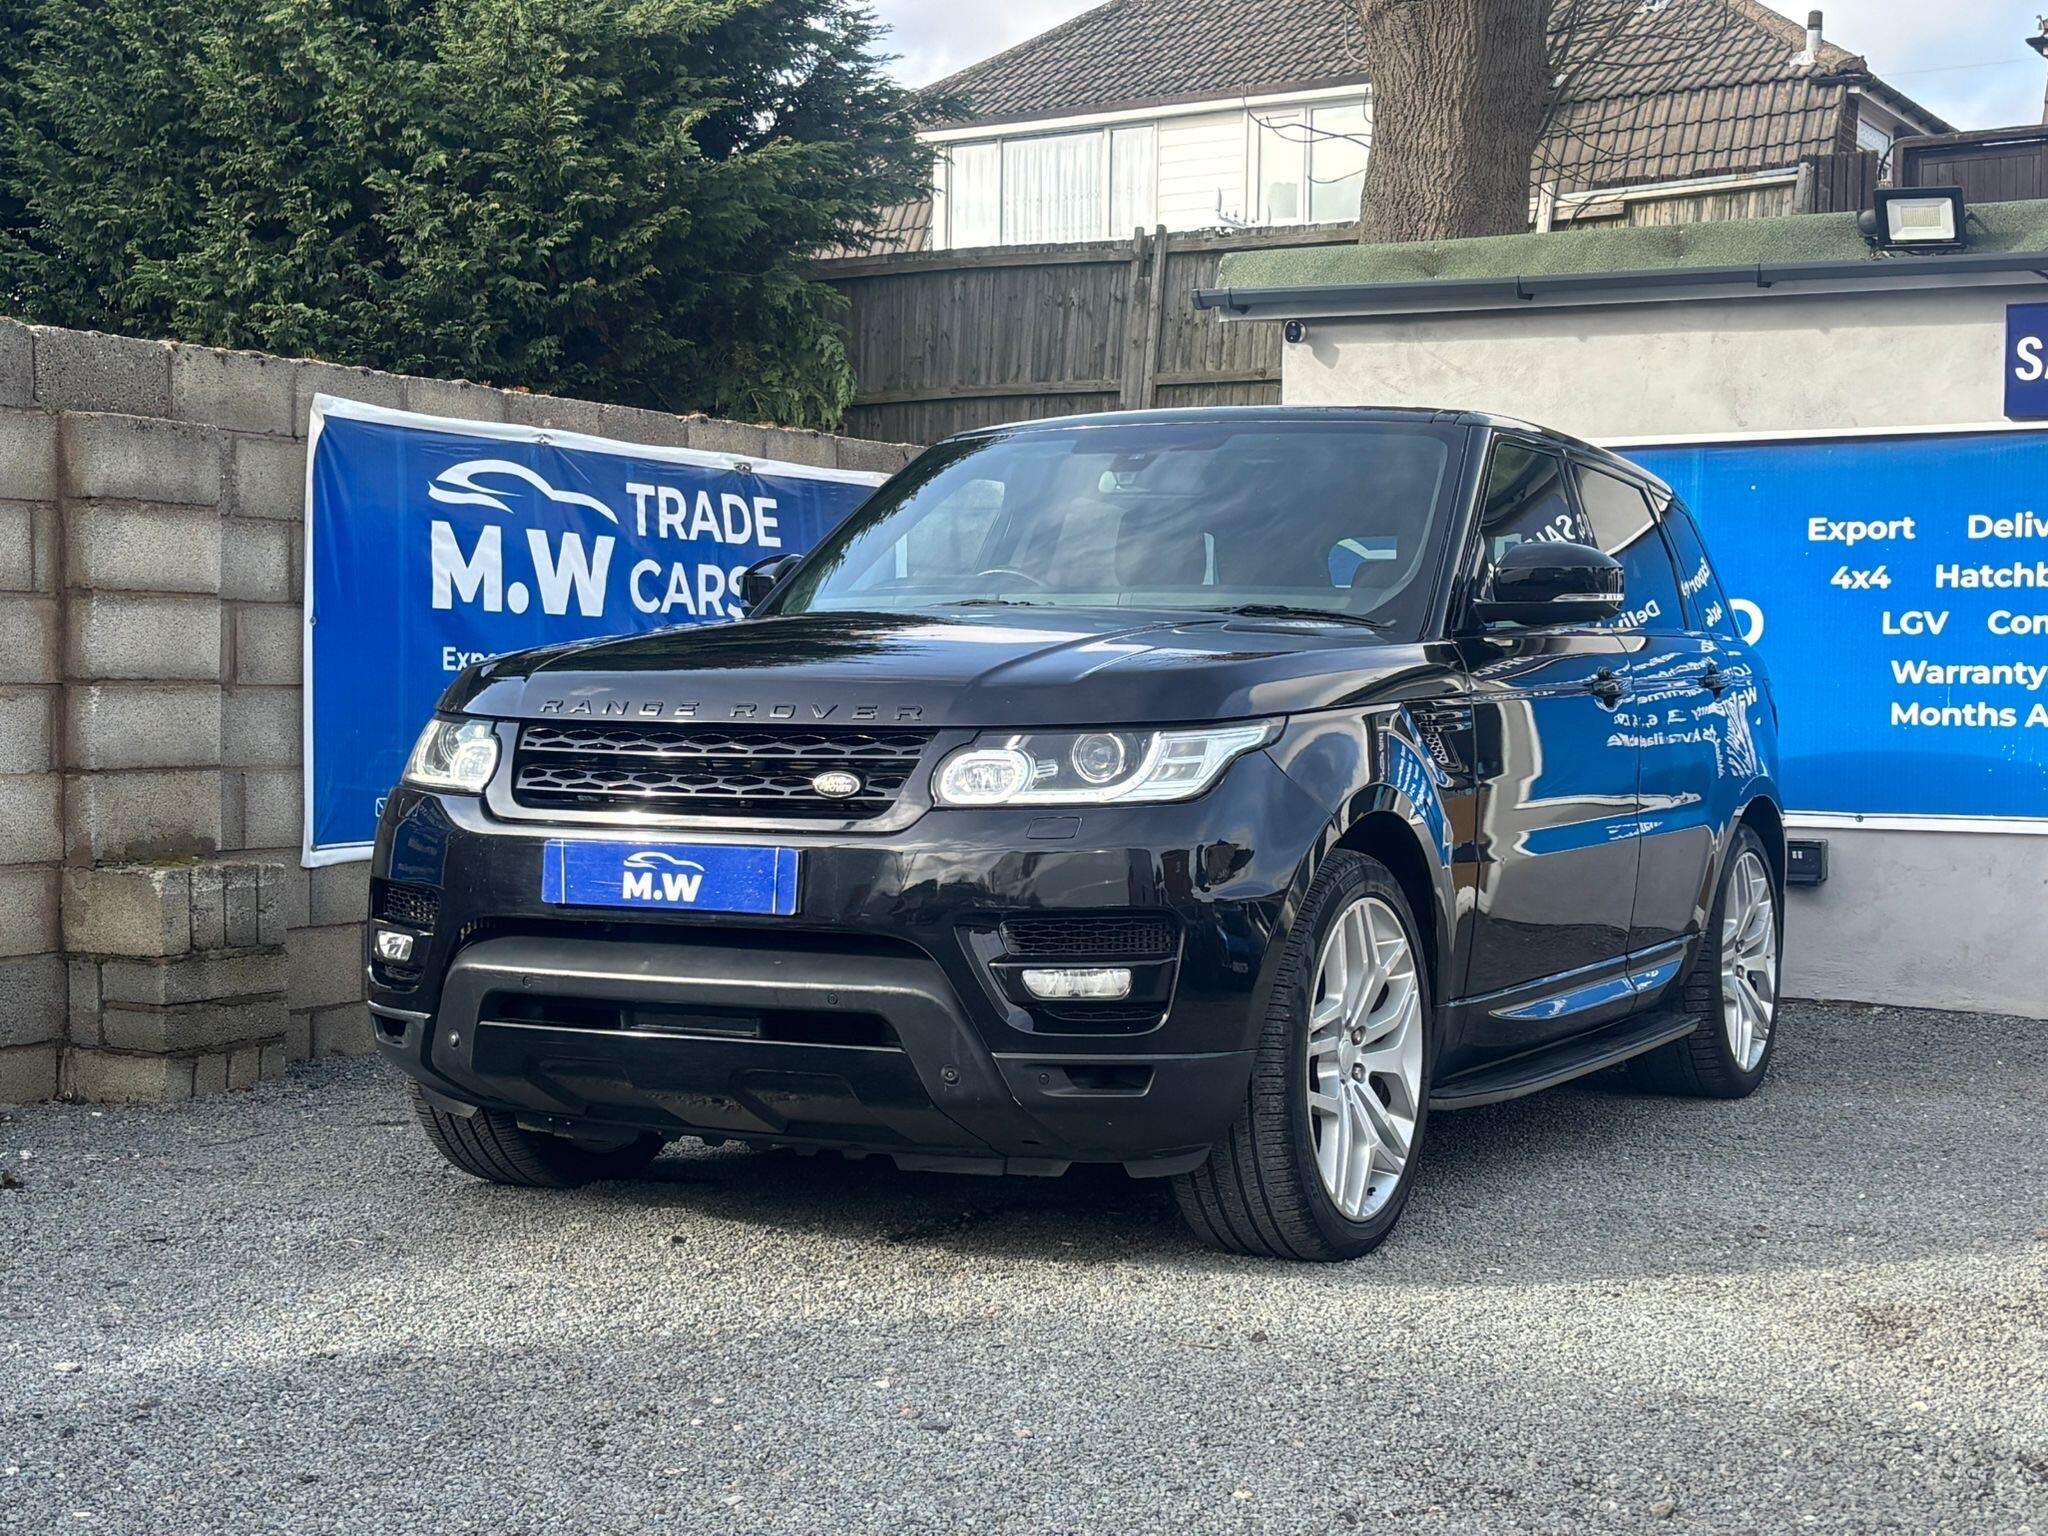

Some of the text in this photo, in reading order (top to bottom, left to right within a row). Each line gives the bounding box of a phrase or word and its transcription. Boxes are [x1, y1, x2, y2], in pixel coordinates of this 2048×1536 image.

[2014, 336, 2048, 381] S
[626, 482, 782, 548] TRADE
[1807, 516, 1916, 546] Export
[431, 519, 616, 618] M.W
[1830, 565, 1892, 590] 4x4
[1881, 610, 1950, 636] LGV
[1890, 660, 2048, 691] Warranty
[539, 698, 924, 721] RANGE ROVER
[1890, 701, 2017, 728] Months
[622, 870, 703, 903] M.W
